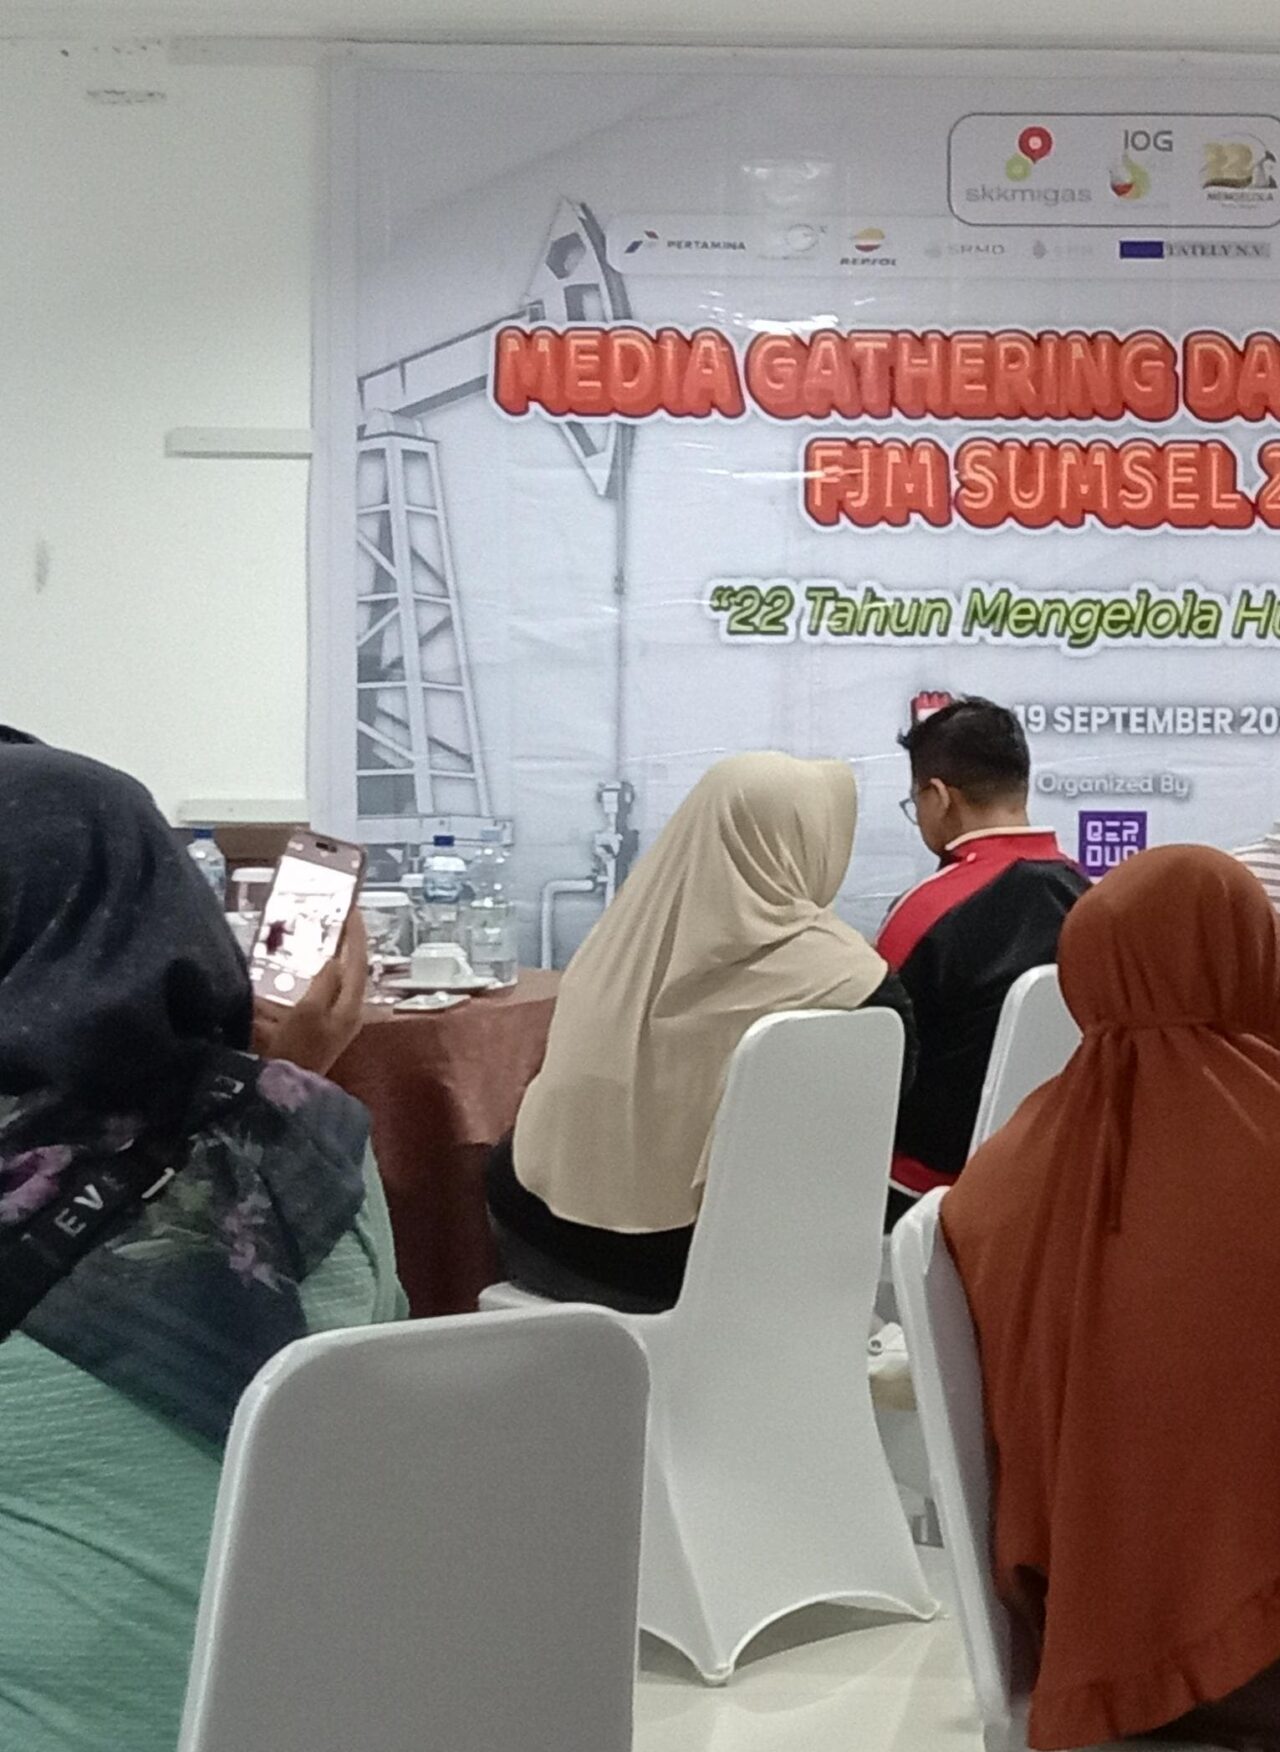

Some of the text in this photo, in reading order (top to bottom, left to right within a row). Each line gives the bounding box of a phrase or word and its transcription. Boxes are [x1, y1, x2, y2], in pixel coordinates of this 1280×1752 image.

[1123, 130, 1174, 152] IOG
[965, 184, 1092, 206] skkmigas
[666, 239, 746, 250] PERTAMINA
[494, 326, 745, 417] MEDIA
[745, 330, 1178, 420] GATHERING
[805, 438, 951, 527] FJM
[954, 438, 1255, 529] SUMSEL
[805, 586, 952, 638] Tahun
[961, 587, 1223, 648] Mengelola
[1053, 705, 1234, 735] SEPTEMBER
[1036, 772, 1190, 797] Organized By
